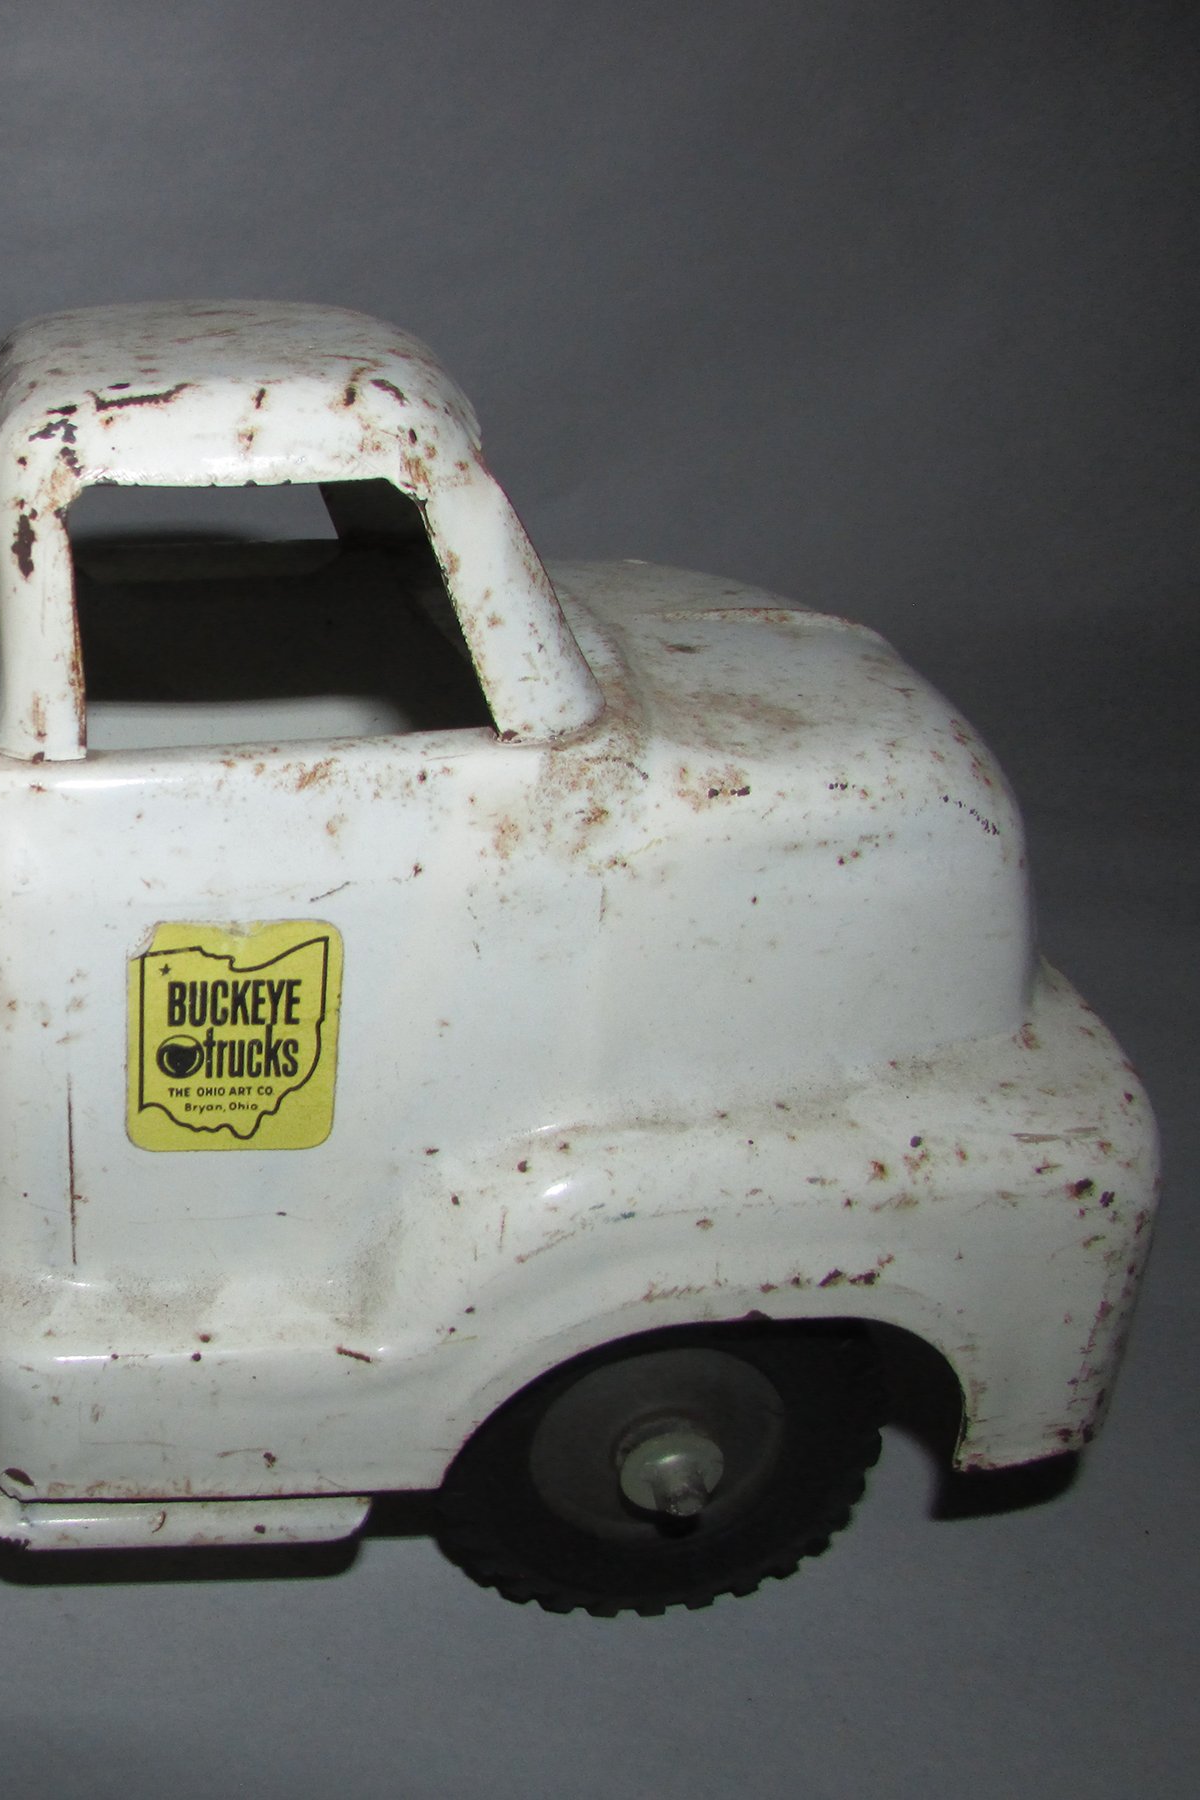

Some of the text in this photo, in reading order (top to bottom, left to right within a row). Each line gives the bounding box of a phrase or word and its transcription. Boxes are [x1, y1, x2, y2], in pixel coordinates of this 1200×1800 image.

[167, 979, 302, 1027] BUCKEYE
[203, 1024, 299, 1079] trucks
[168, 1087, 191, 1098] THE
[196, 1087, 226, 1097] OHIO
[229, 1086, 252, 1097] ART
[185, 1102, 259, 1114] Bryan, Ohio
